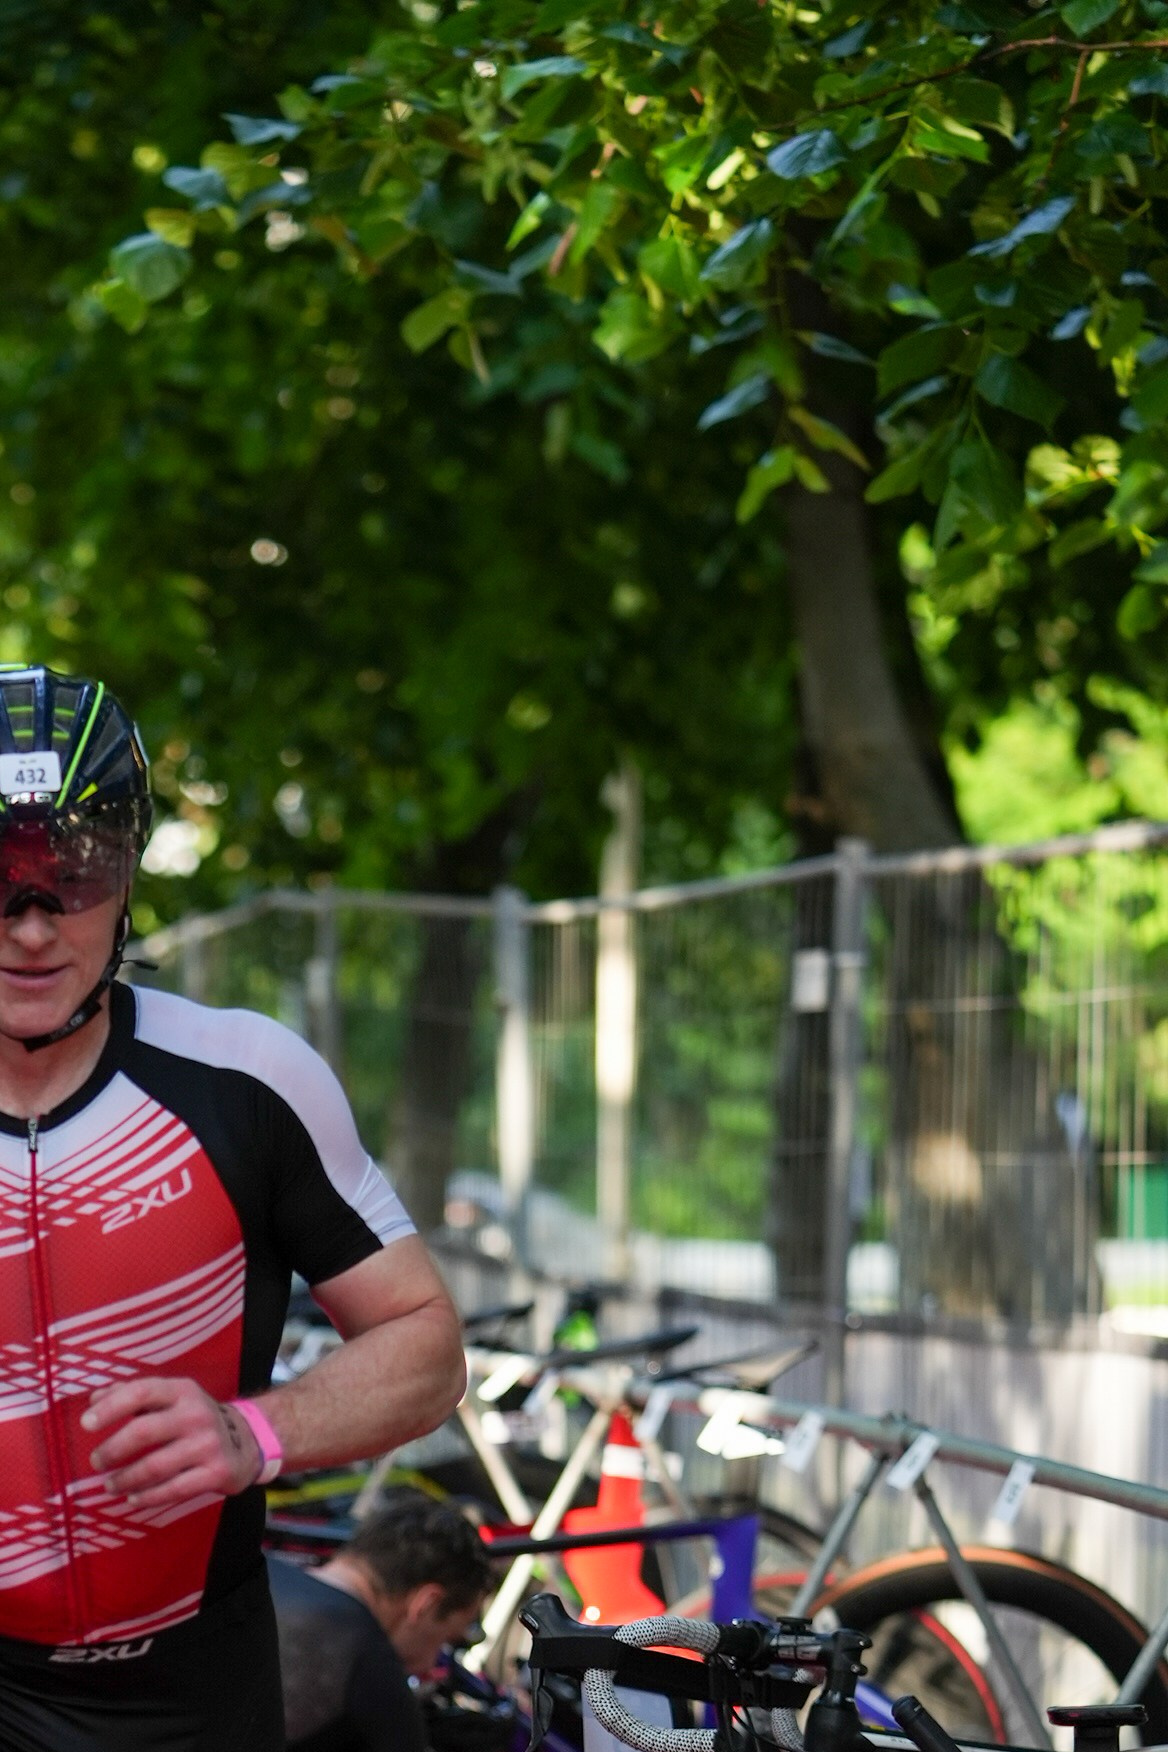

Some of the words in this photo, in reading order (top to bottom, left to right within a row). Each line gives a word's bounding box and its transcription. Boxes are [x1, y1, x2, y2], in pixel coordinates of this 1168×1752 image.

[15, 768, 47, 784] 432
[100, 1167, 192, 1234] 2XU
[48, 1638, 153, 1662] 2XU
